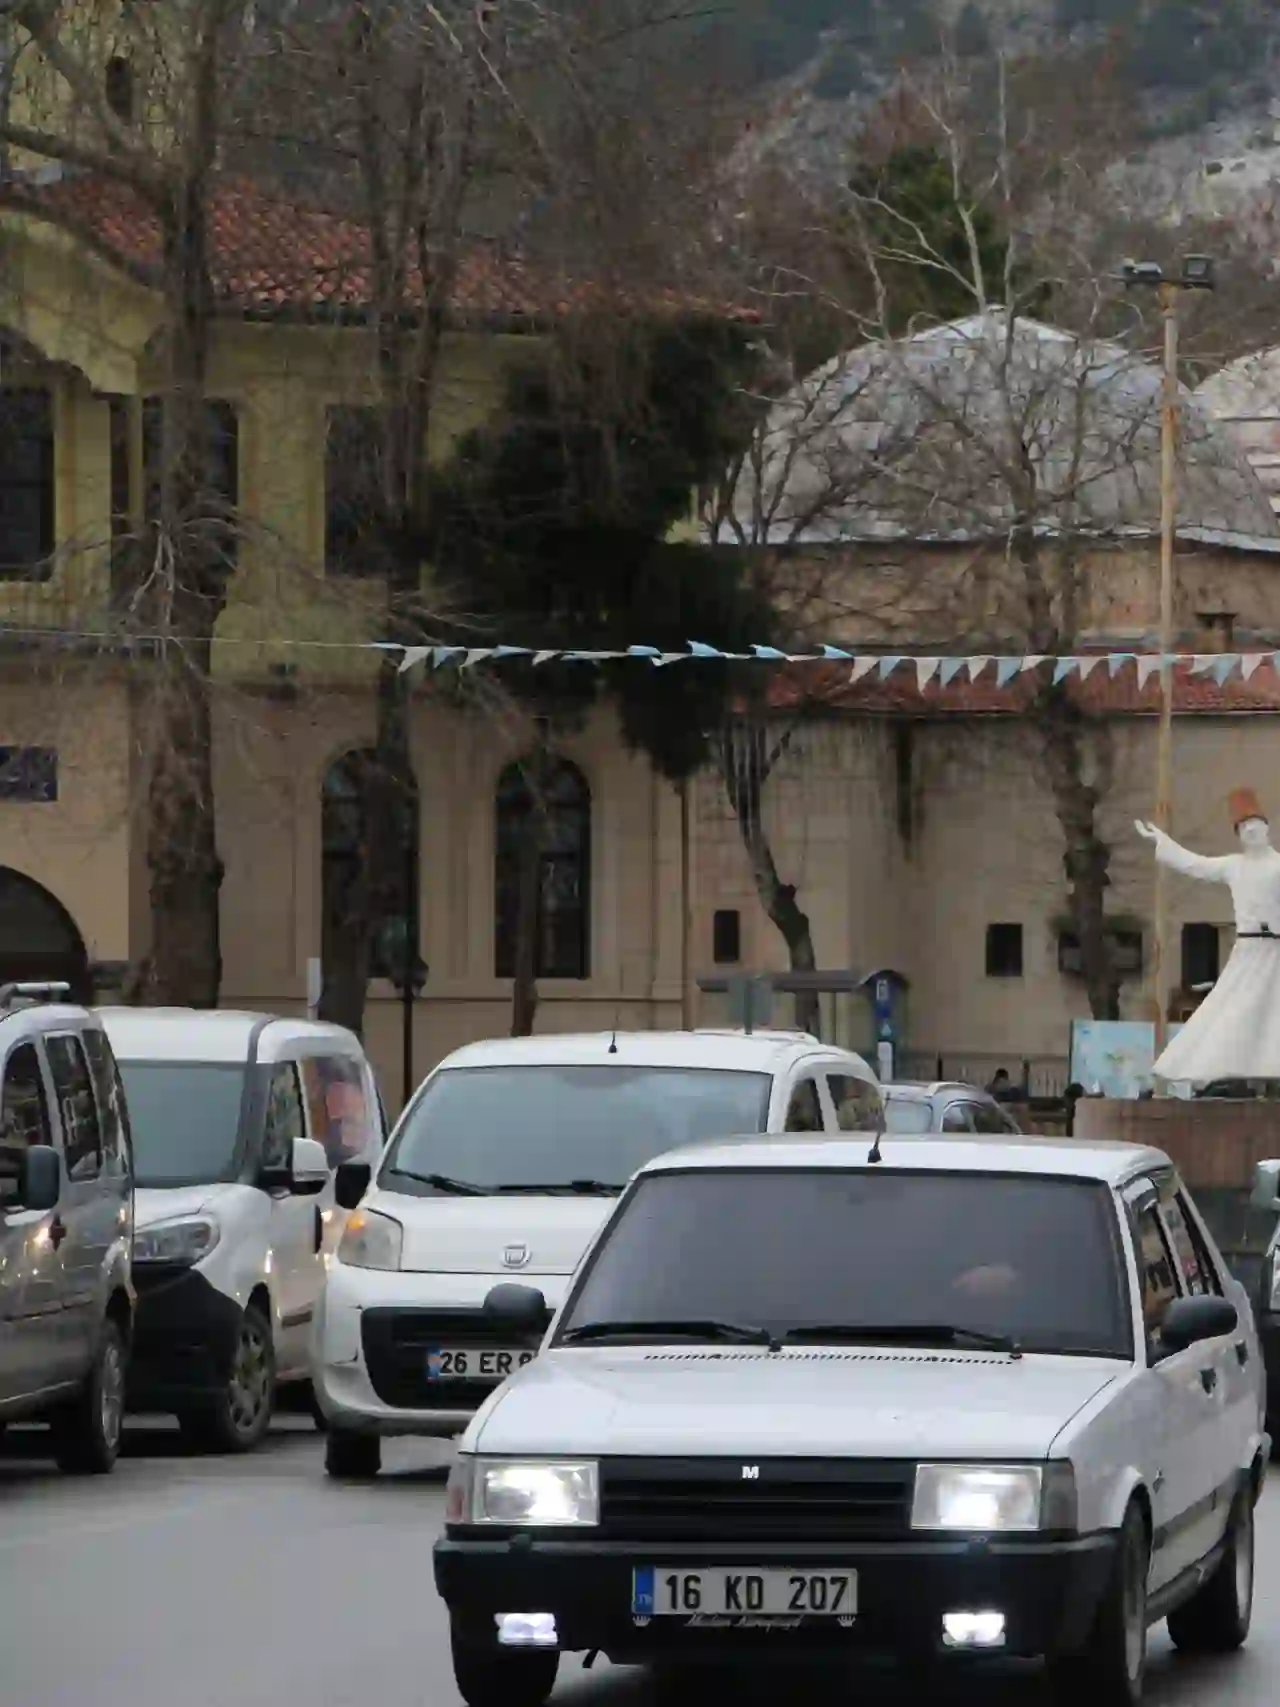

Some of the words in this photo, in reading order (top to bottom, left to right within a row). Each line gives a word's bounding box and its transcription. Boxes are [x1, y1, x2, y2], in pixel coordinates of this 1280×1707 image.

[440, 1352, 468, 1373] 26
[480, 1352, 512, 1374] ER
[665, 1574, 701, 1610] 16
[787, 1576, 850, 1611] 207
